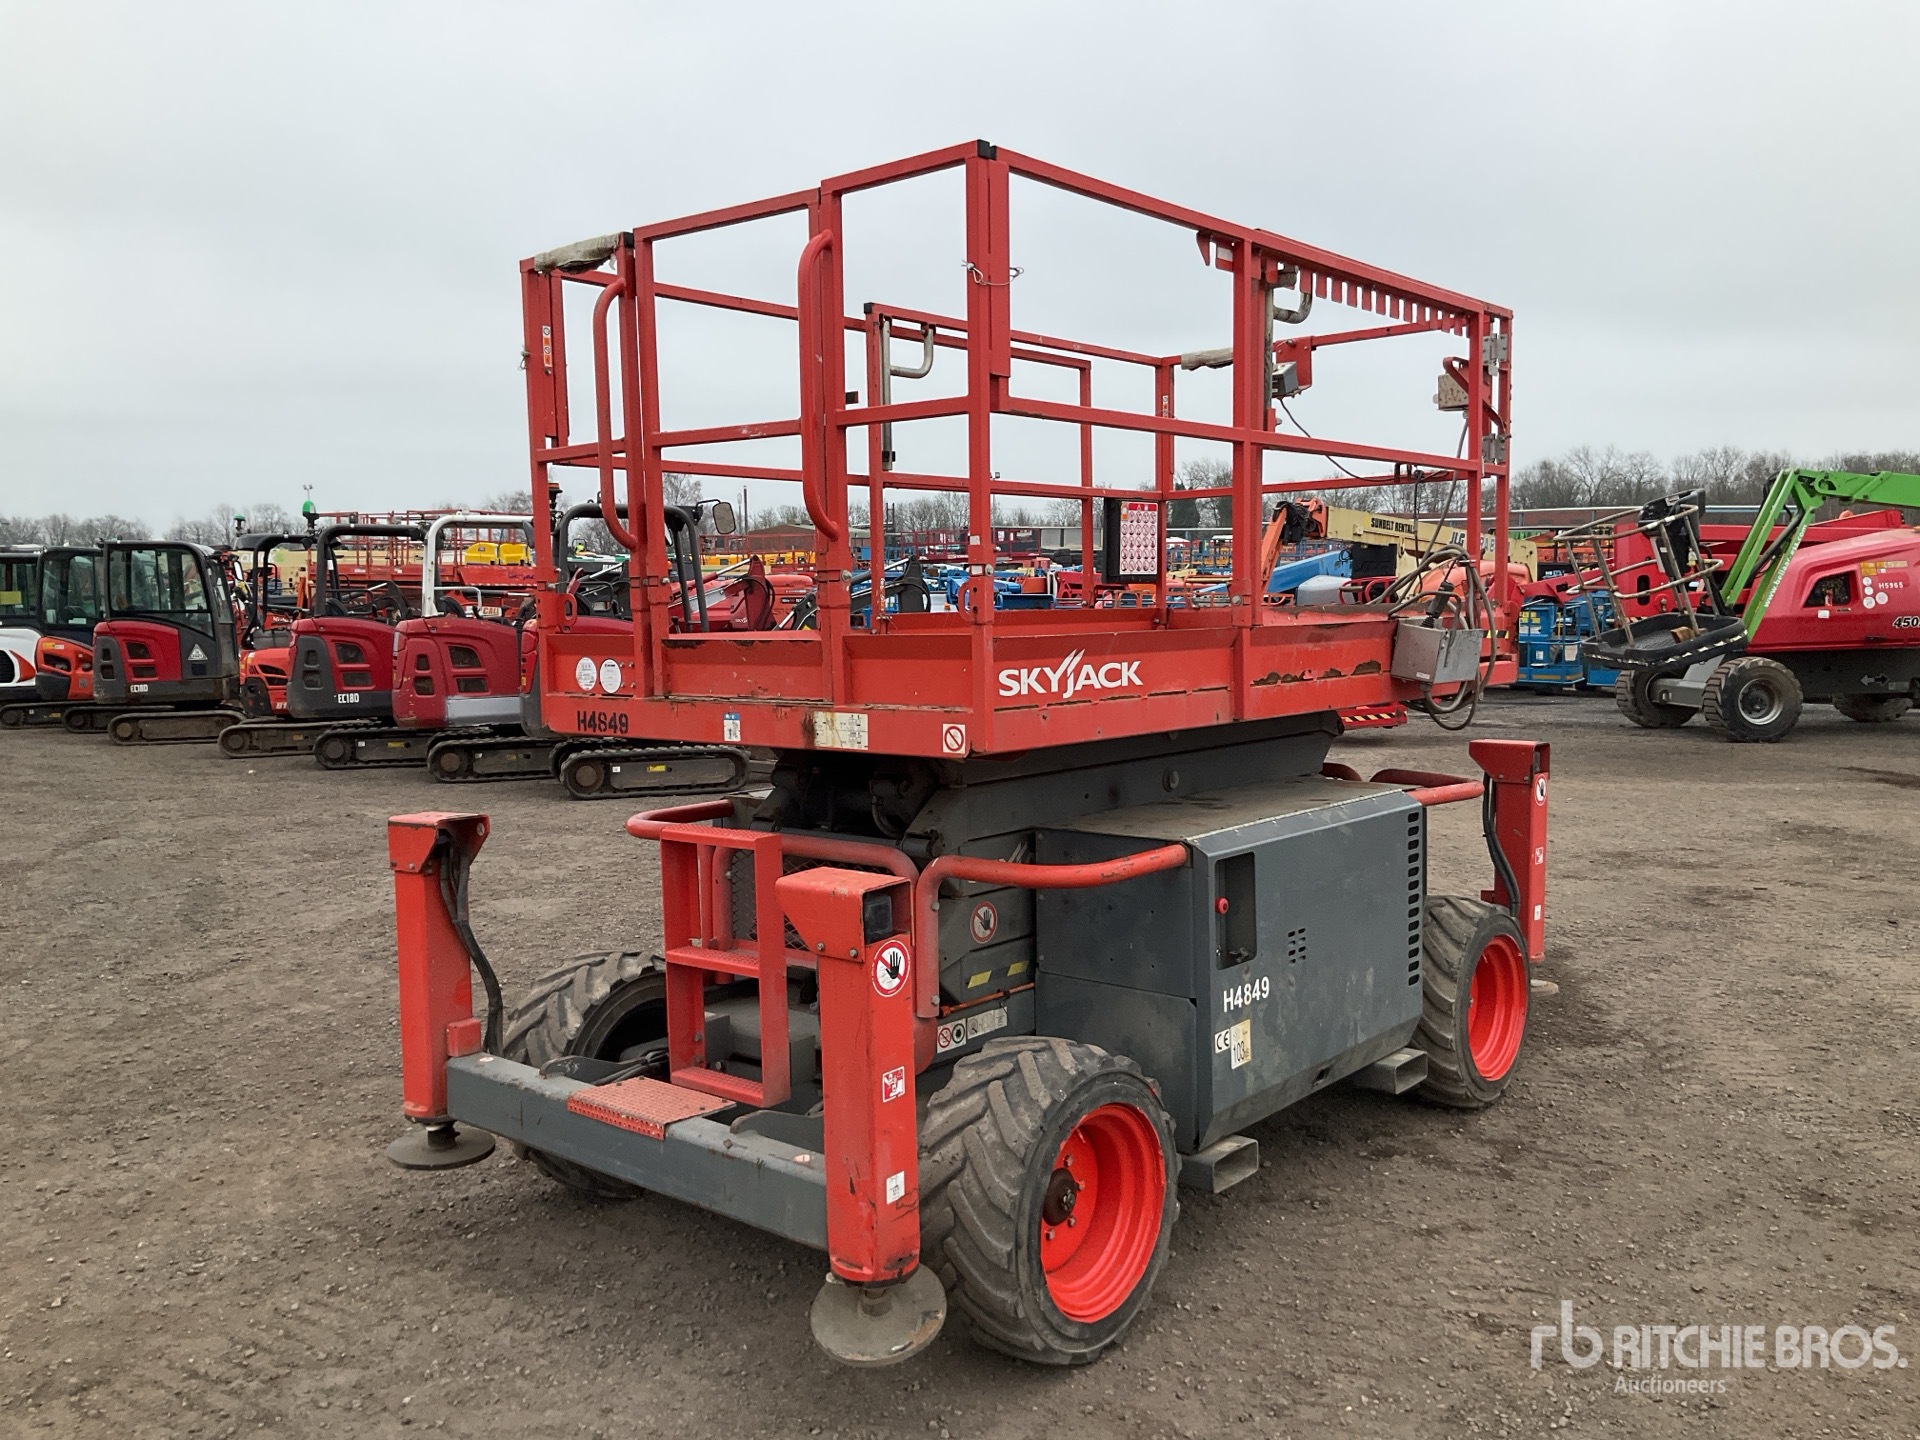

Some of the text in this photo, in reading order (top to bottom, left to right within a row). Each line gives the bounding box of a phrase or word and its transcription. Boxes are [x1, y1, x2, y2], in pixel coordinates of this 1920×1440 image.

[1371, 518, 1394, 531] SUNBELT
[1449, 531, 1466, 547] JLG
[1892, 615, 1920, 629] 450
[998, 648, 1144, 699] SKYJACK
[576, 710, 629, 735] H4849
[1223, 976, 1270, 1013] H4849
[1216, 1030, 1230, 1050] CE
